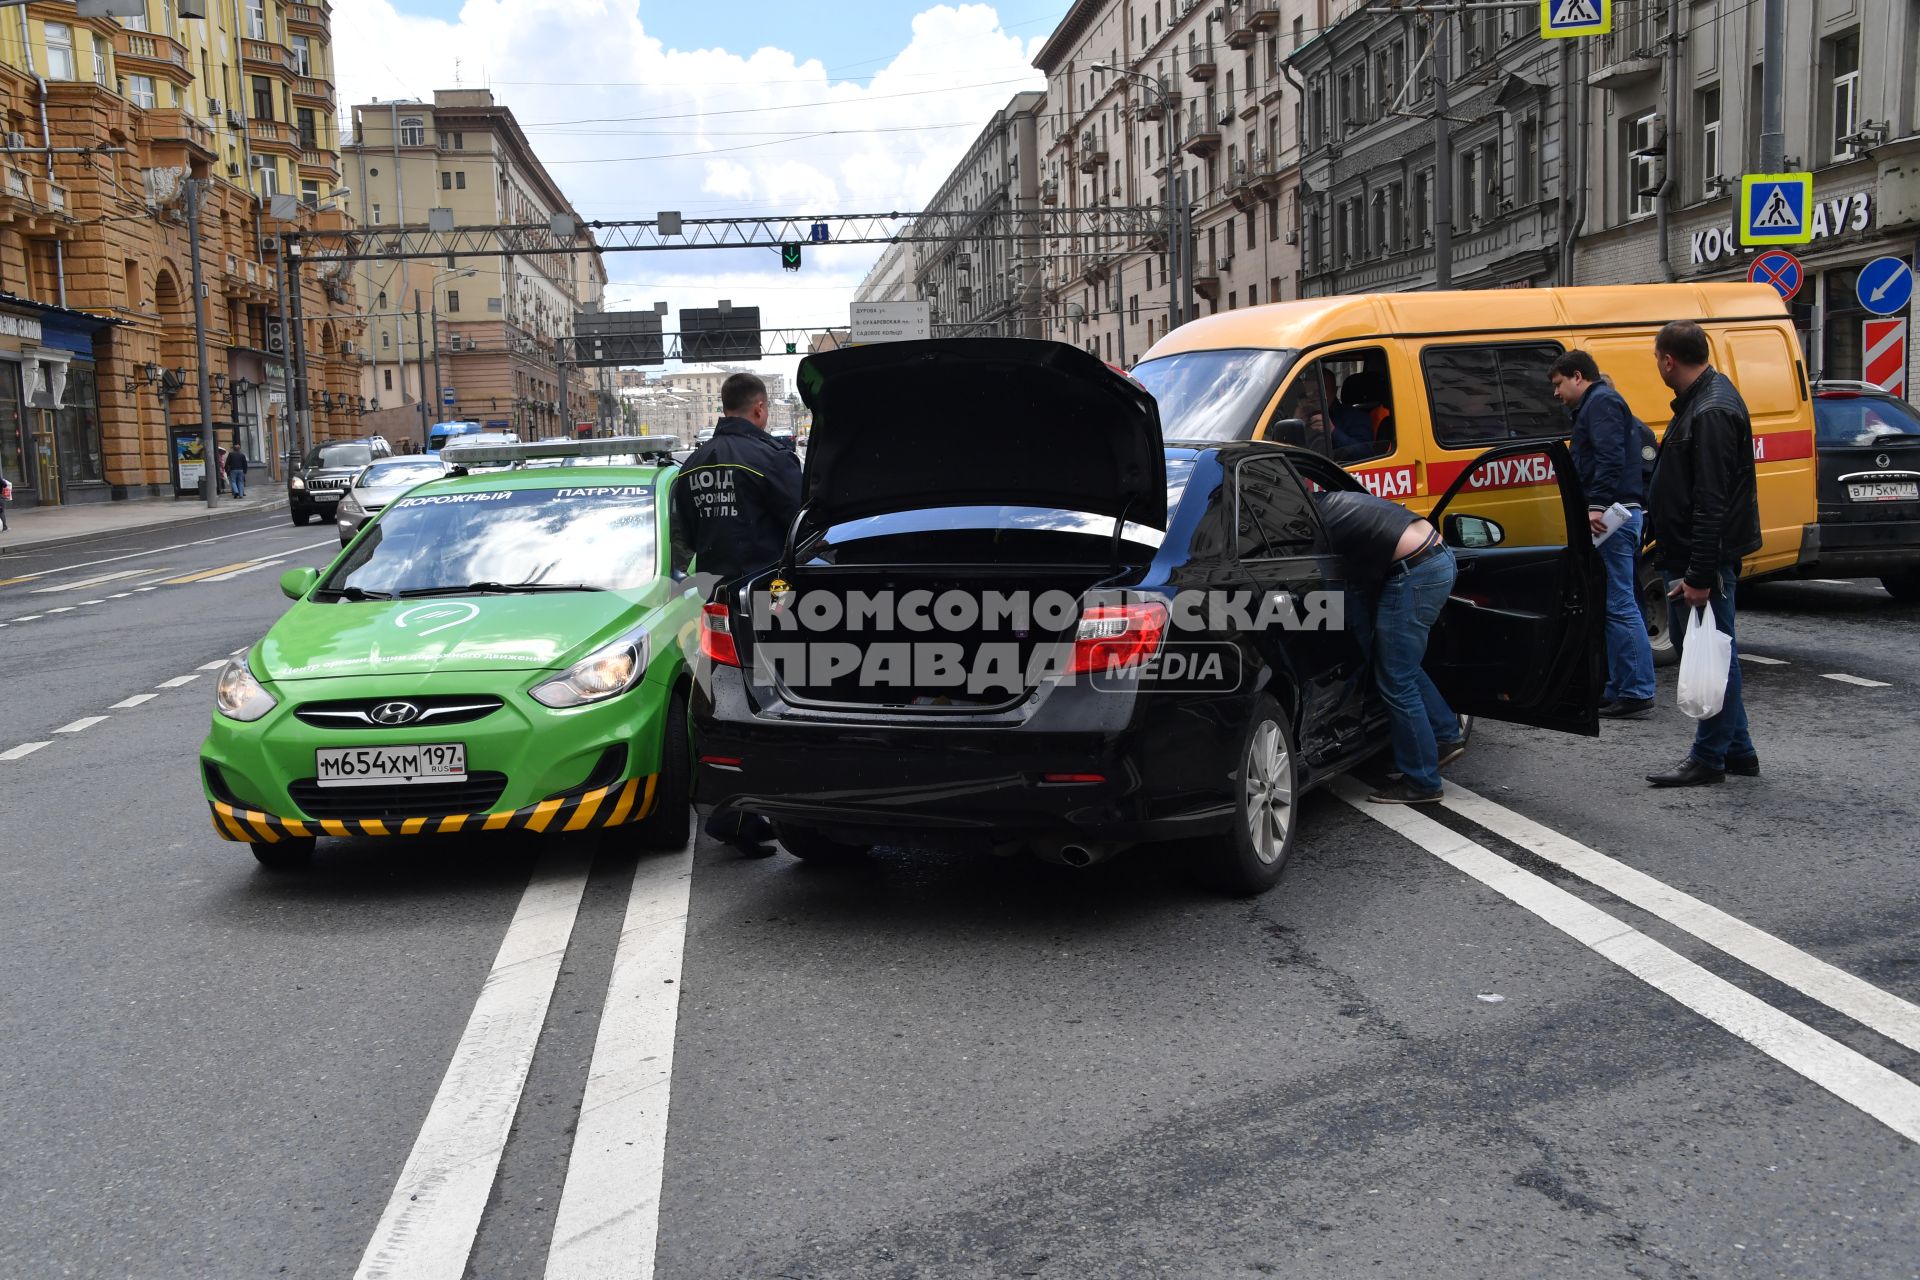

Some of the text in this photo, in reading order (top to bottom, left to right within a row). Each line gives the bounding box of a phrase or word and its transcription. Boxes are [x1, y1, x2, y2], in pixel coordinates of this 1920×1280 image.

[1811, 192, 1870, 240] АУЗ
[396, 487, 648, 508] ДОРОЖНЫЙ ПАТРУЛЬ
[324, 747, 457, 776] М654ХМ 197
[431, 765, 449, 773] RUS
